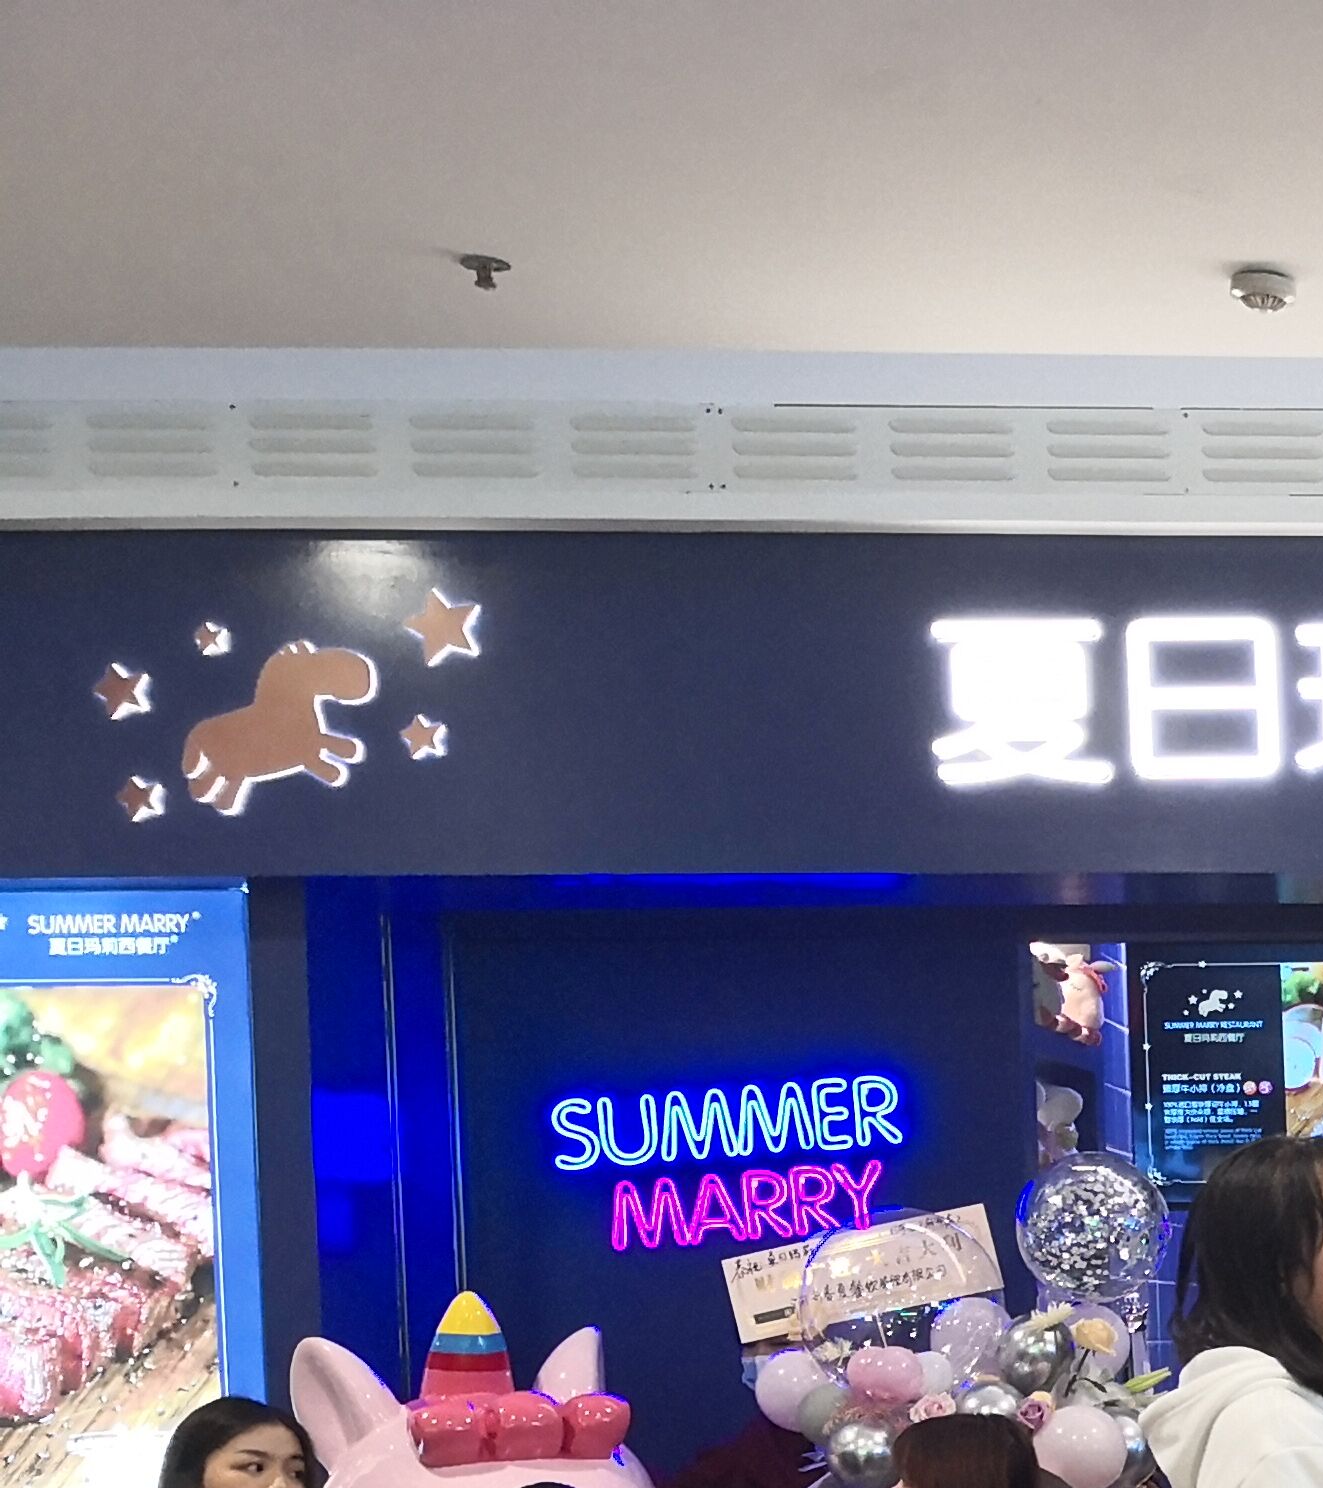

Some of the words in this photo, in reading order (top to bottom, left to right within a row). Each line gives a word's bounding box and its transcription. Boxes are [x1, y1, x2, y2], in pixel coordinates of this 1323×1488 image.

[26, 912, 117, 935] SUMMER
[119, 912, 190, 934] MARRY
[549, 1074, 904, 1170] SUMMER
[610, 1159, 882, 1251] MARRY
